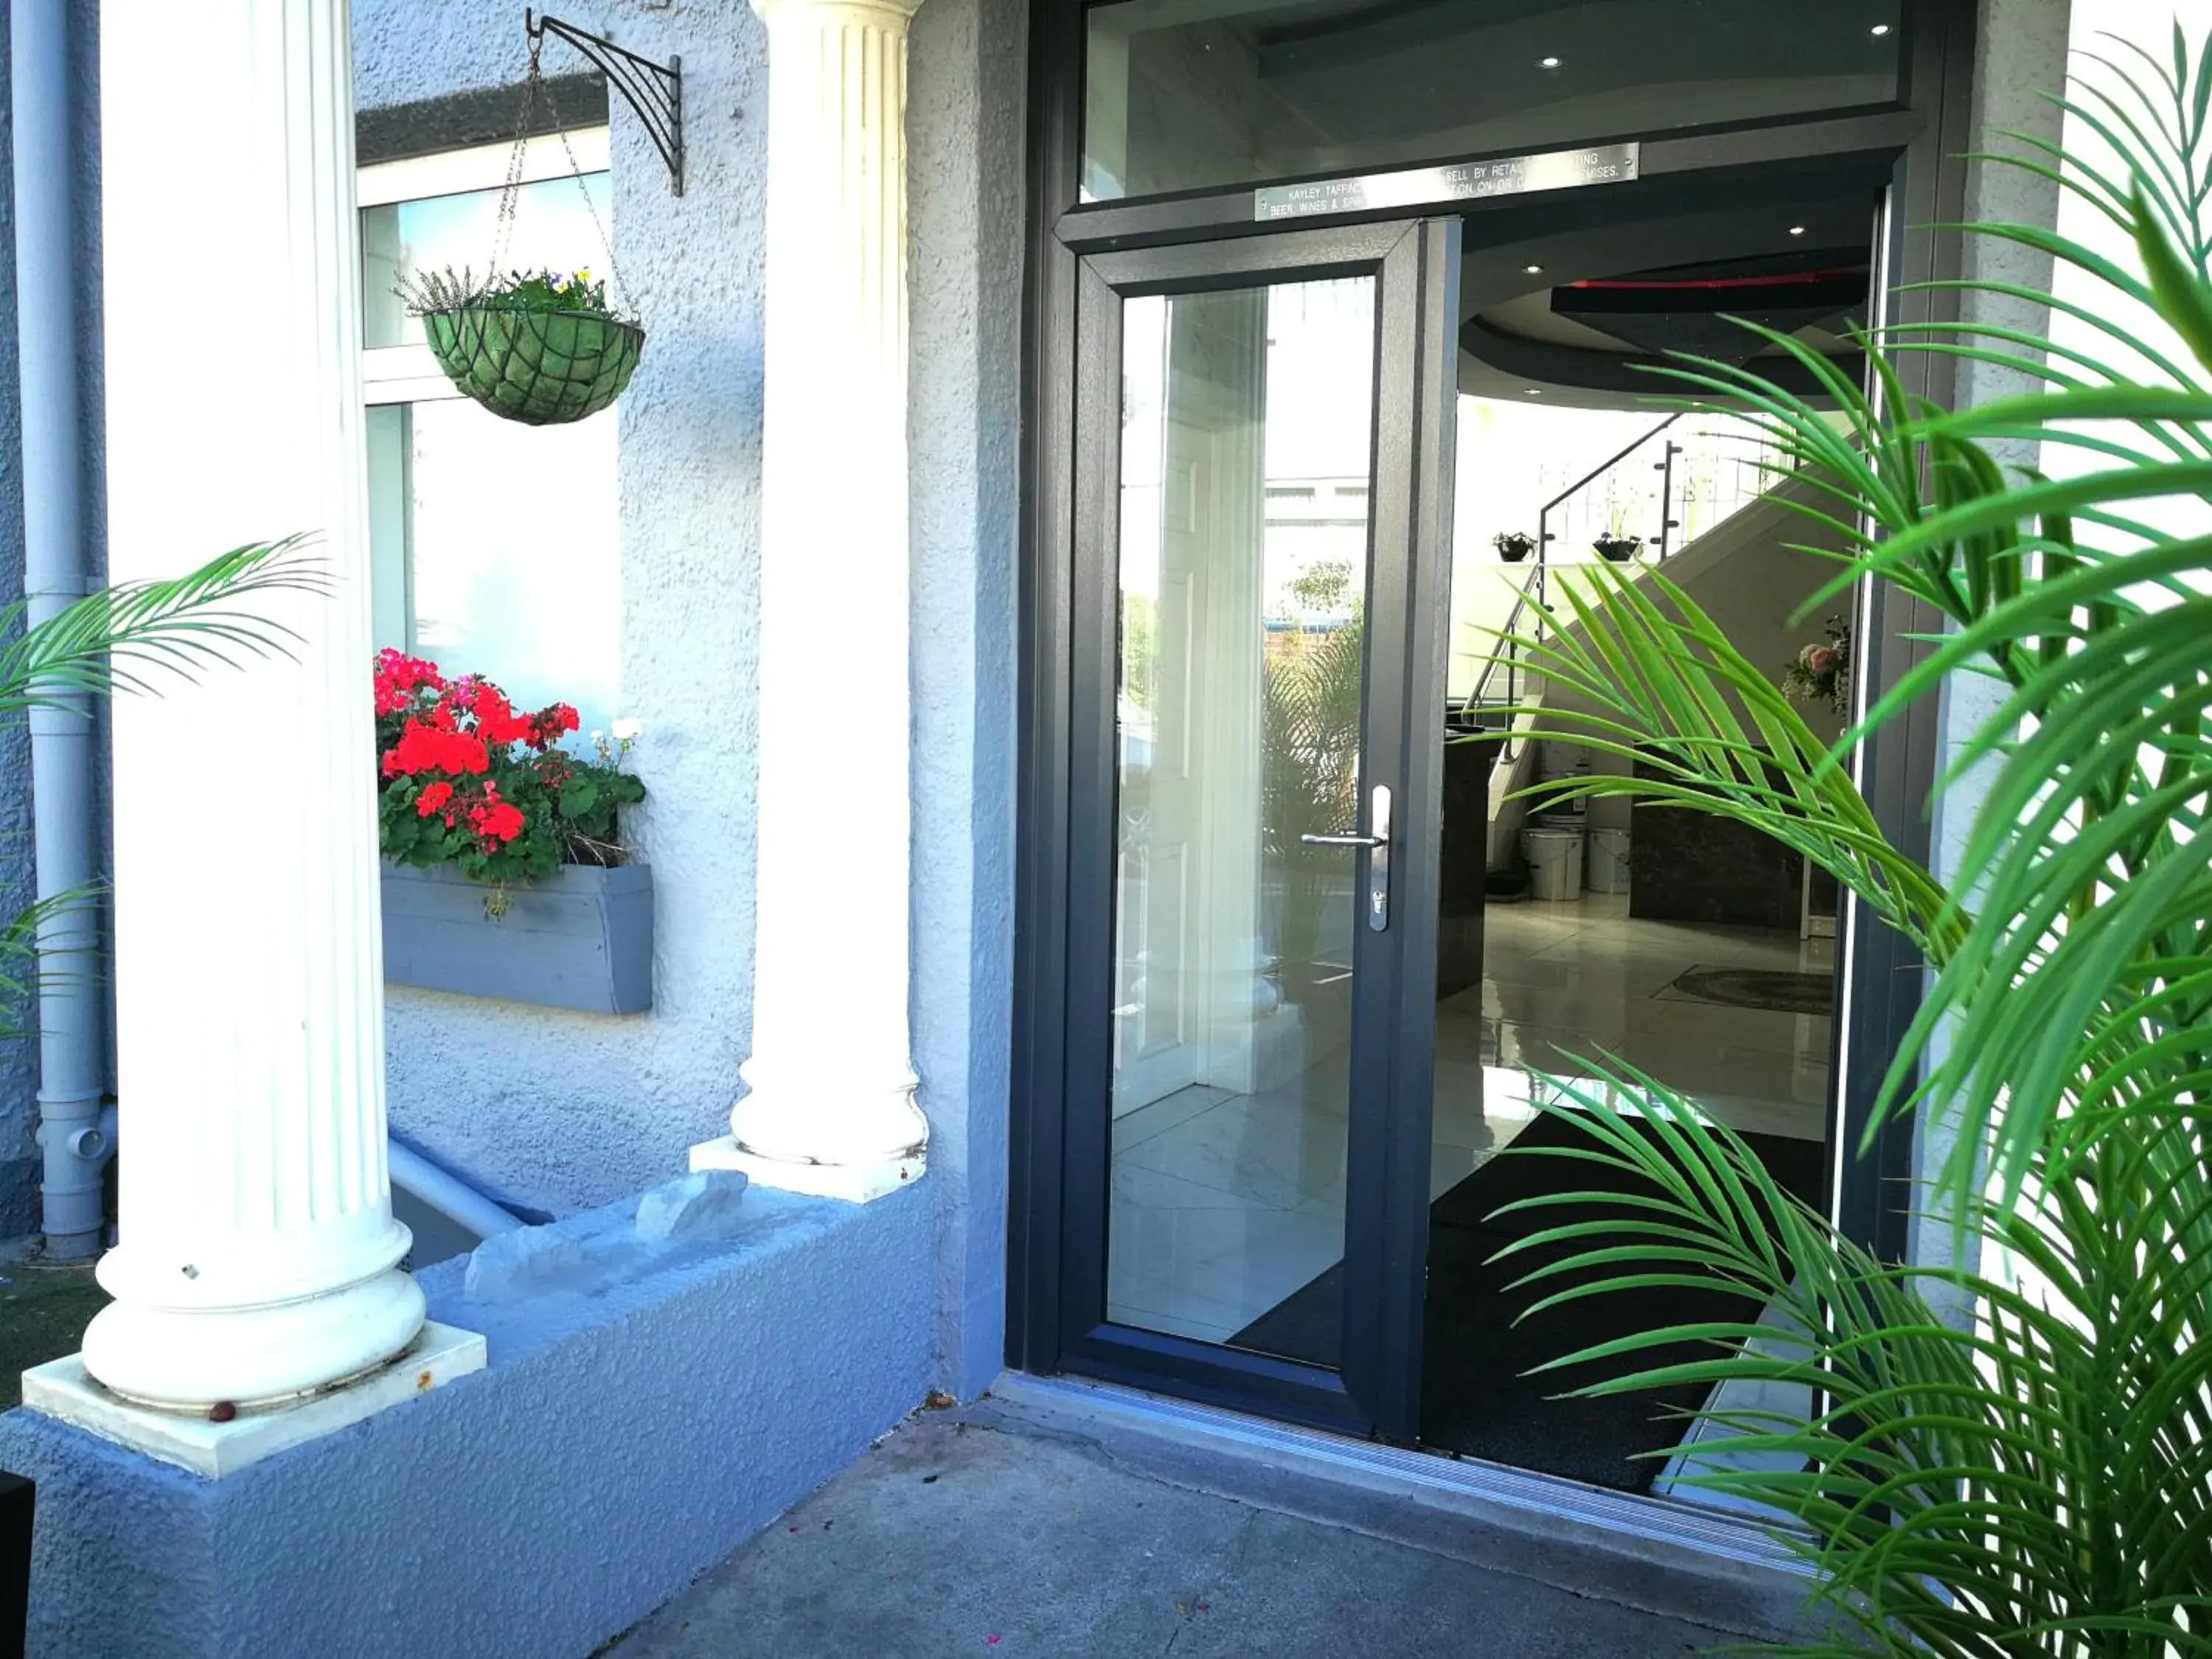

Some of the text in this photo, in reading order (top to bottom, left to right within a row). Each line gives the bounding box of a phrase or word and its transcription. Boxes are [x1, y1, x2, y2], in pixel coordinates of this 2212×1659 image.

[1288, 187, 1321, 201] KAYLEY
[1446, 170, 1468, 182] SELL
[1475, 167, 1486, 179] BY
[1300, 200, 1326, 213] WINES
